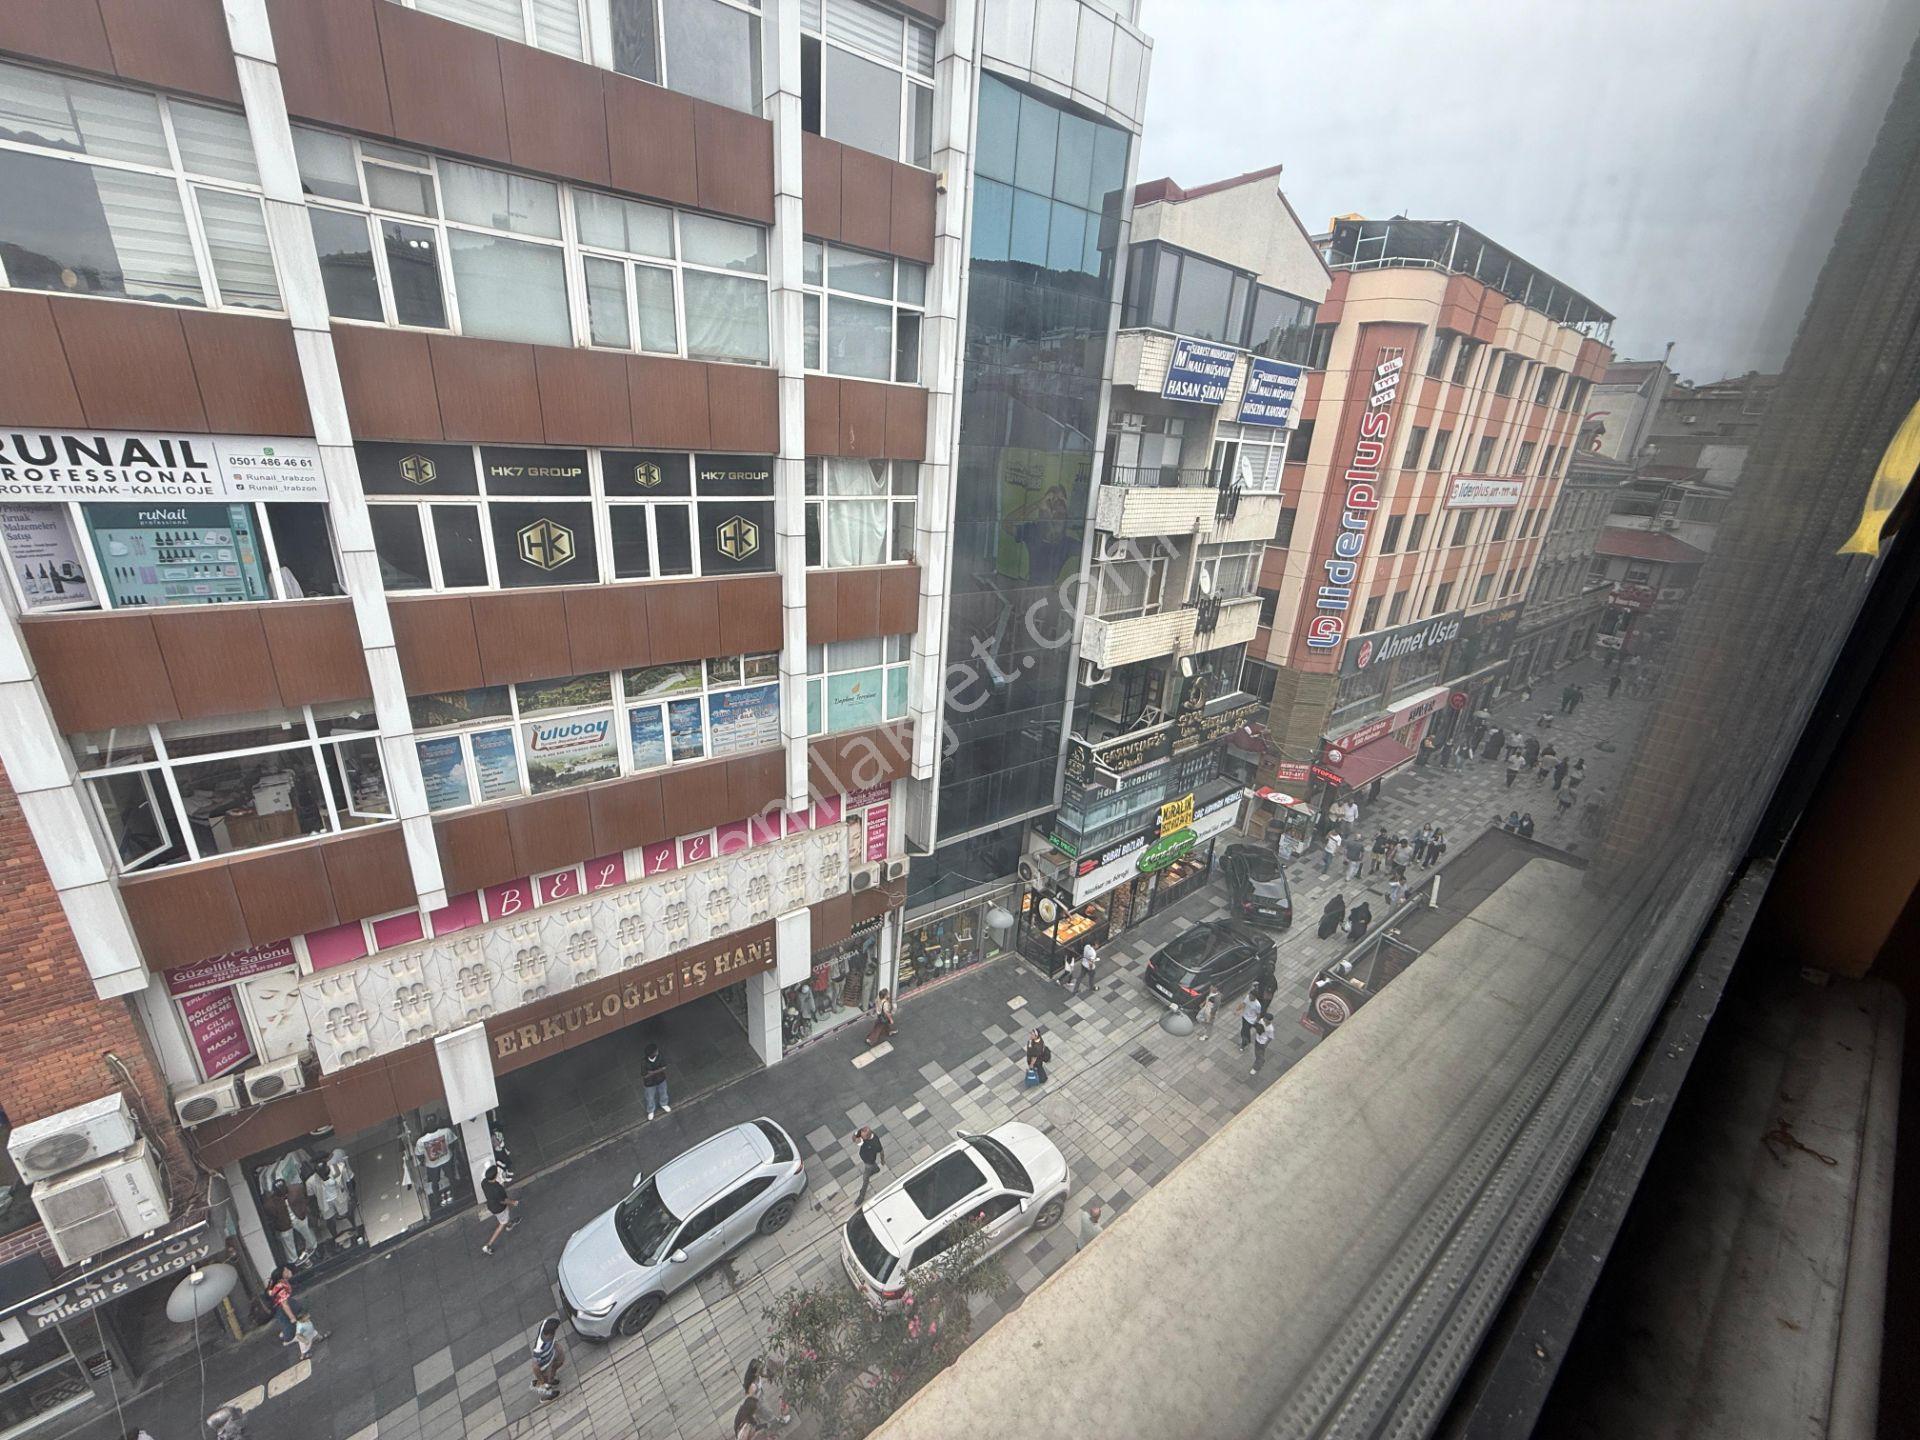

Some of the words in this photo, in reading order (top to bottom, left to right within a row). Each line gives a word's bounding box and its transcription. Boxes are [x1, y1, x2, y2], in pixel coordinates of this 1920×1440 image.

[1378, 375, 1395, 388] TYT
[1167, 380, 1200, 397] HASAN
[1200, 381, 1226, 402] ŞİRİN
[1375, 391, 1391, 404] AYT
[229, 457, 257, 466] 0501
[260, 458, 281, 467] 486
[284, 459, 298, 467] 46
[1, 468, 212, 484] ROFESSIONAL
[491, 466, 524, 477] HK7
[528, 467, 582, 478] GROUP
[701, 471, 726, 480] HK7
[728, 472, 769, 481] GROUP
[0, 484, 56, 495] ROTEZ
[186, 486, 214, 496] OJE
[139, 508, 188, 520] ruNail
[1316, 411, 1390, 610] liderplus
[3, 522, 57, 531] Malzemeleri
[6, 533, 32, 541] Satışı
[1374, 627, 1428, 664] Ahmet
[1428, 620, 1460, 646] Usta
[1119, 769, 1161, 789] Extensions
[1312, 766, 1343, 782] OTOPARK
[173, 959, 236, 982] Güzellik
[240, 946, 290, 965] Salonu
[188, 995, 233, 1022] BÖLGESEL
[494, 970, 675, 1058] ERKULOĞLU
[681, 960, 708, 988] İŞ
[201, 1020, 235, 1042] BAKIMI
[207, 1017, 226, 1031] CİLT
[207, 1032, 238, 1054] MASAJ
[37, 1289, 108, 1328] Mikail
[112, 1282, 129, 1294] &
[136, 1245, 210, 1283] Turgay
